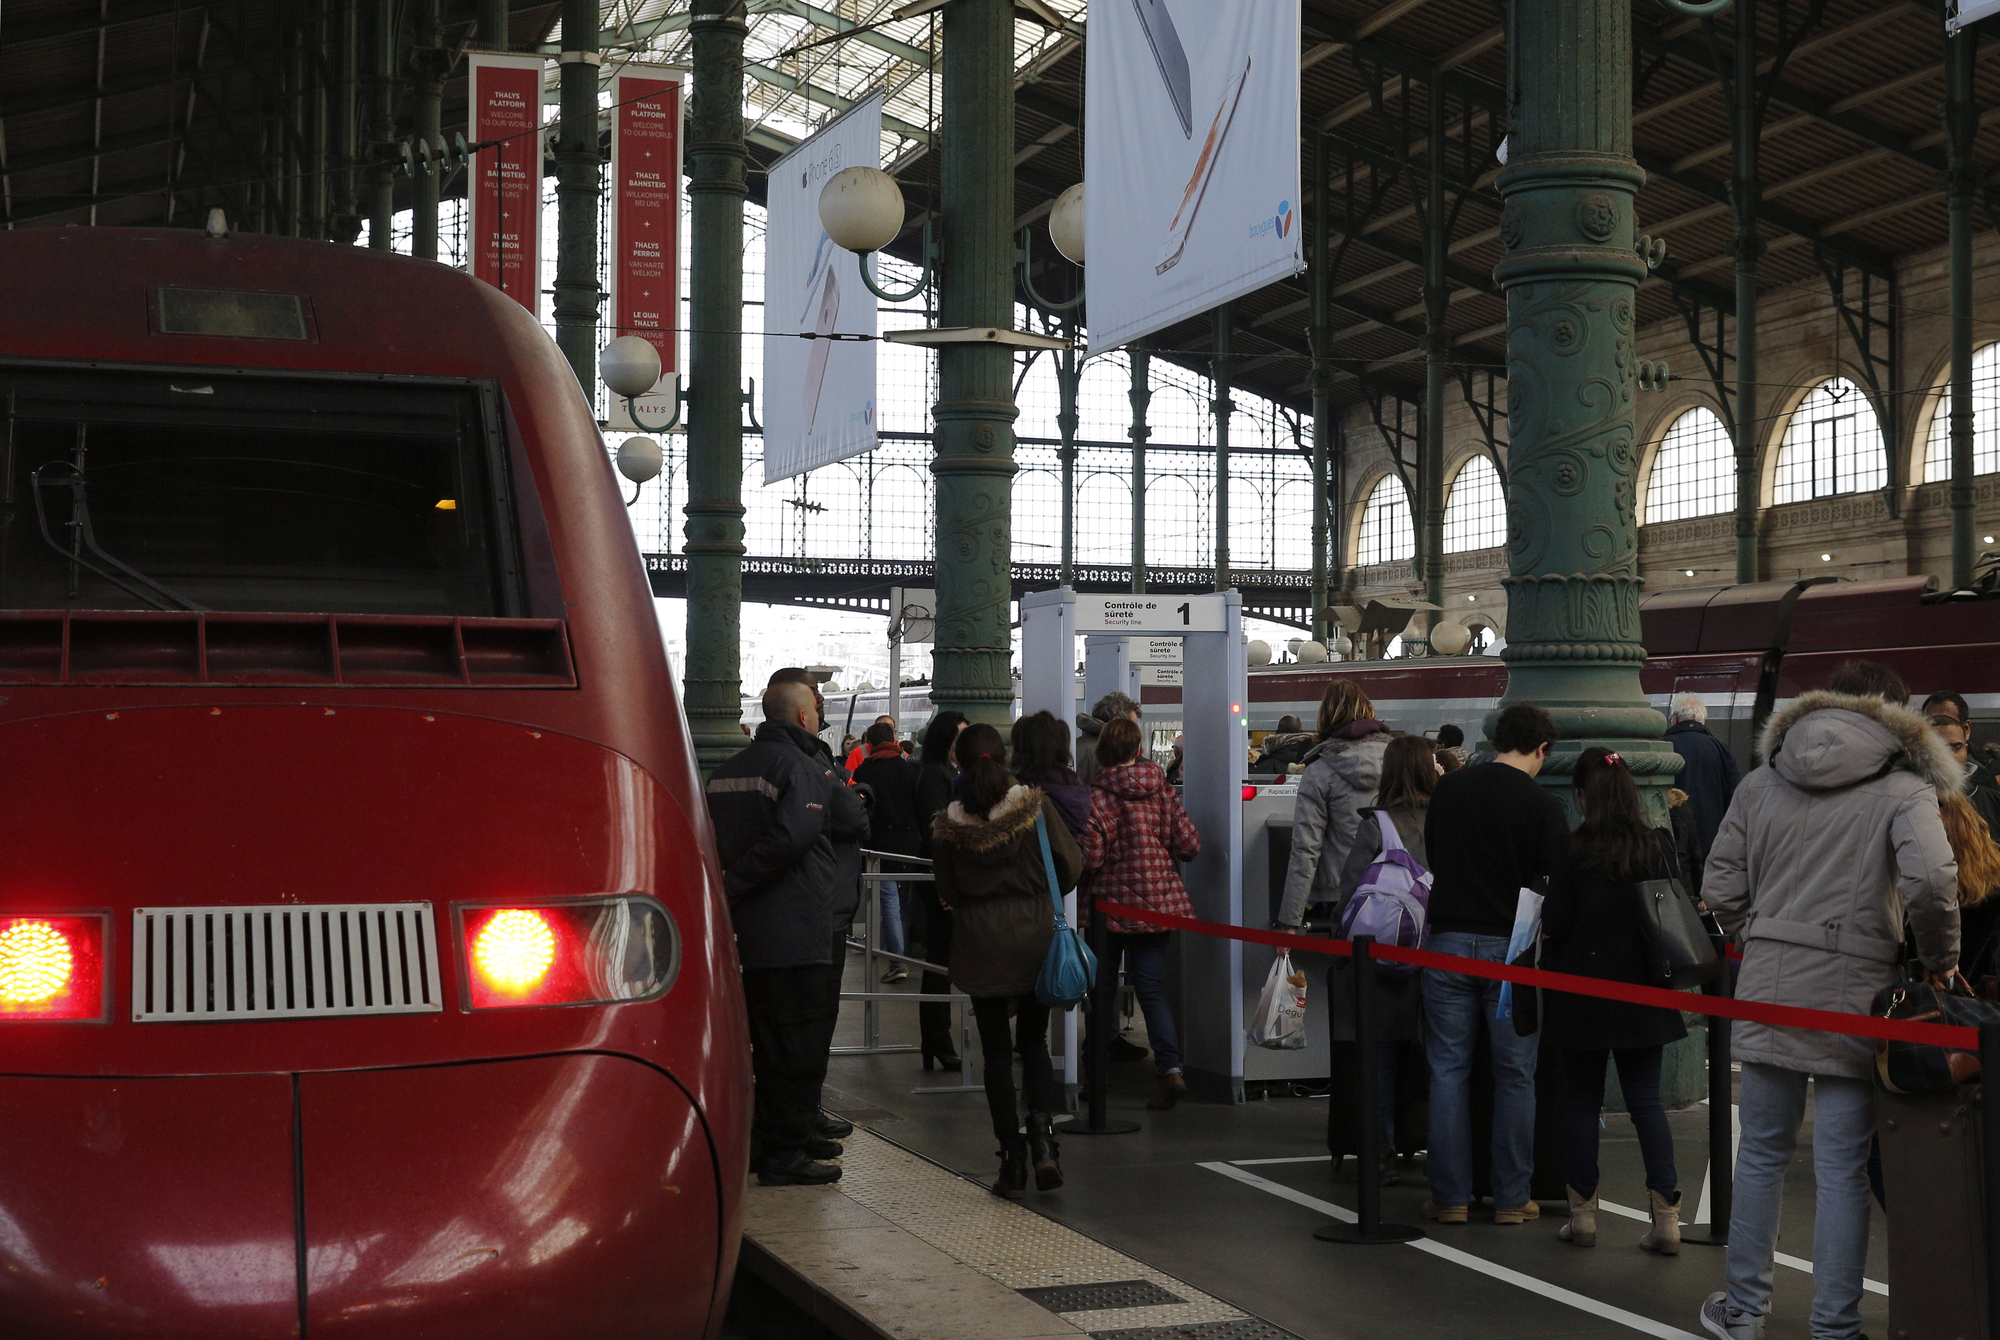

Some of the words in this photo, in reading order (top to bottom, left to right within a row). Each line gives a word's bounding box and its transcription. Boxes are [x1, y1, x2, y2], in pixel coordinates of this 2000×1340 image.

[490, 100, 525, 108] PLATFORM
[490, 111, 524, 119] WELCOME
[631, 110, 665, 118] PLATFORM
[632, 122, 664, 130] WELCOME
[809, 158, 828, 185] iPhone
[629, 180, 666, 188] BAHNSTEIG
[625, 191, 669, 199] WILLKOMMEN
[1177, 602, 1190, 625] 1
